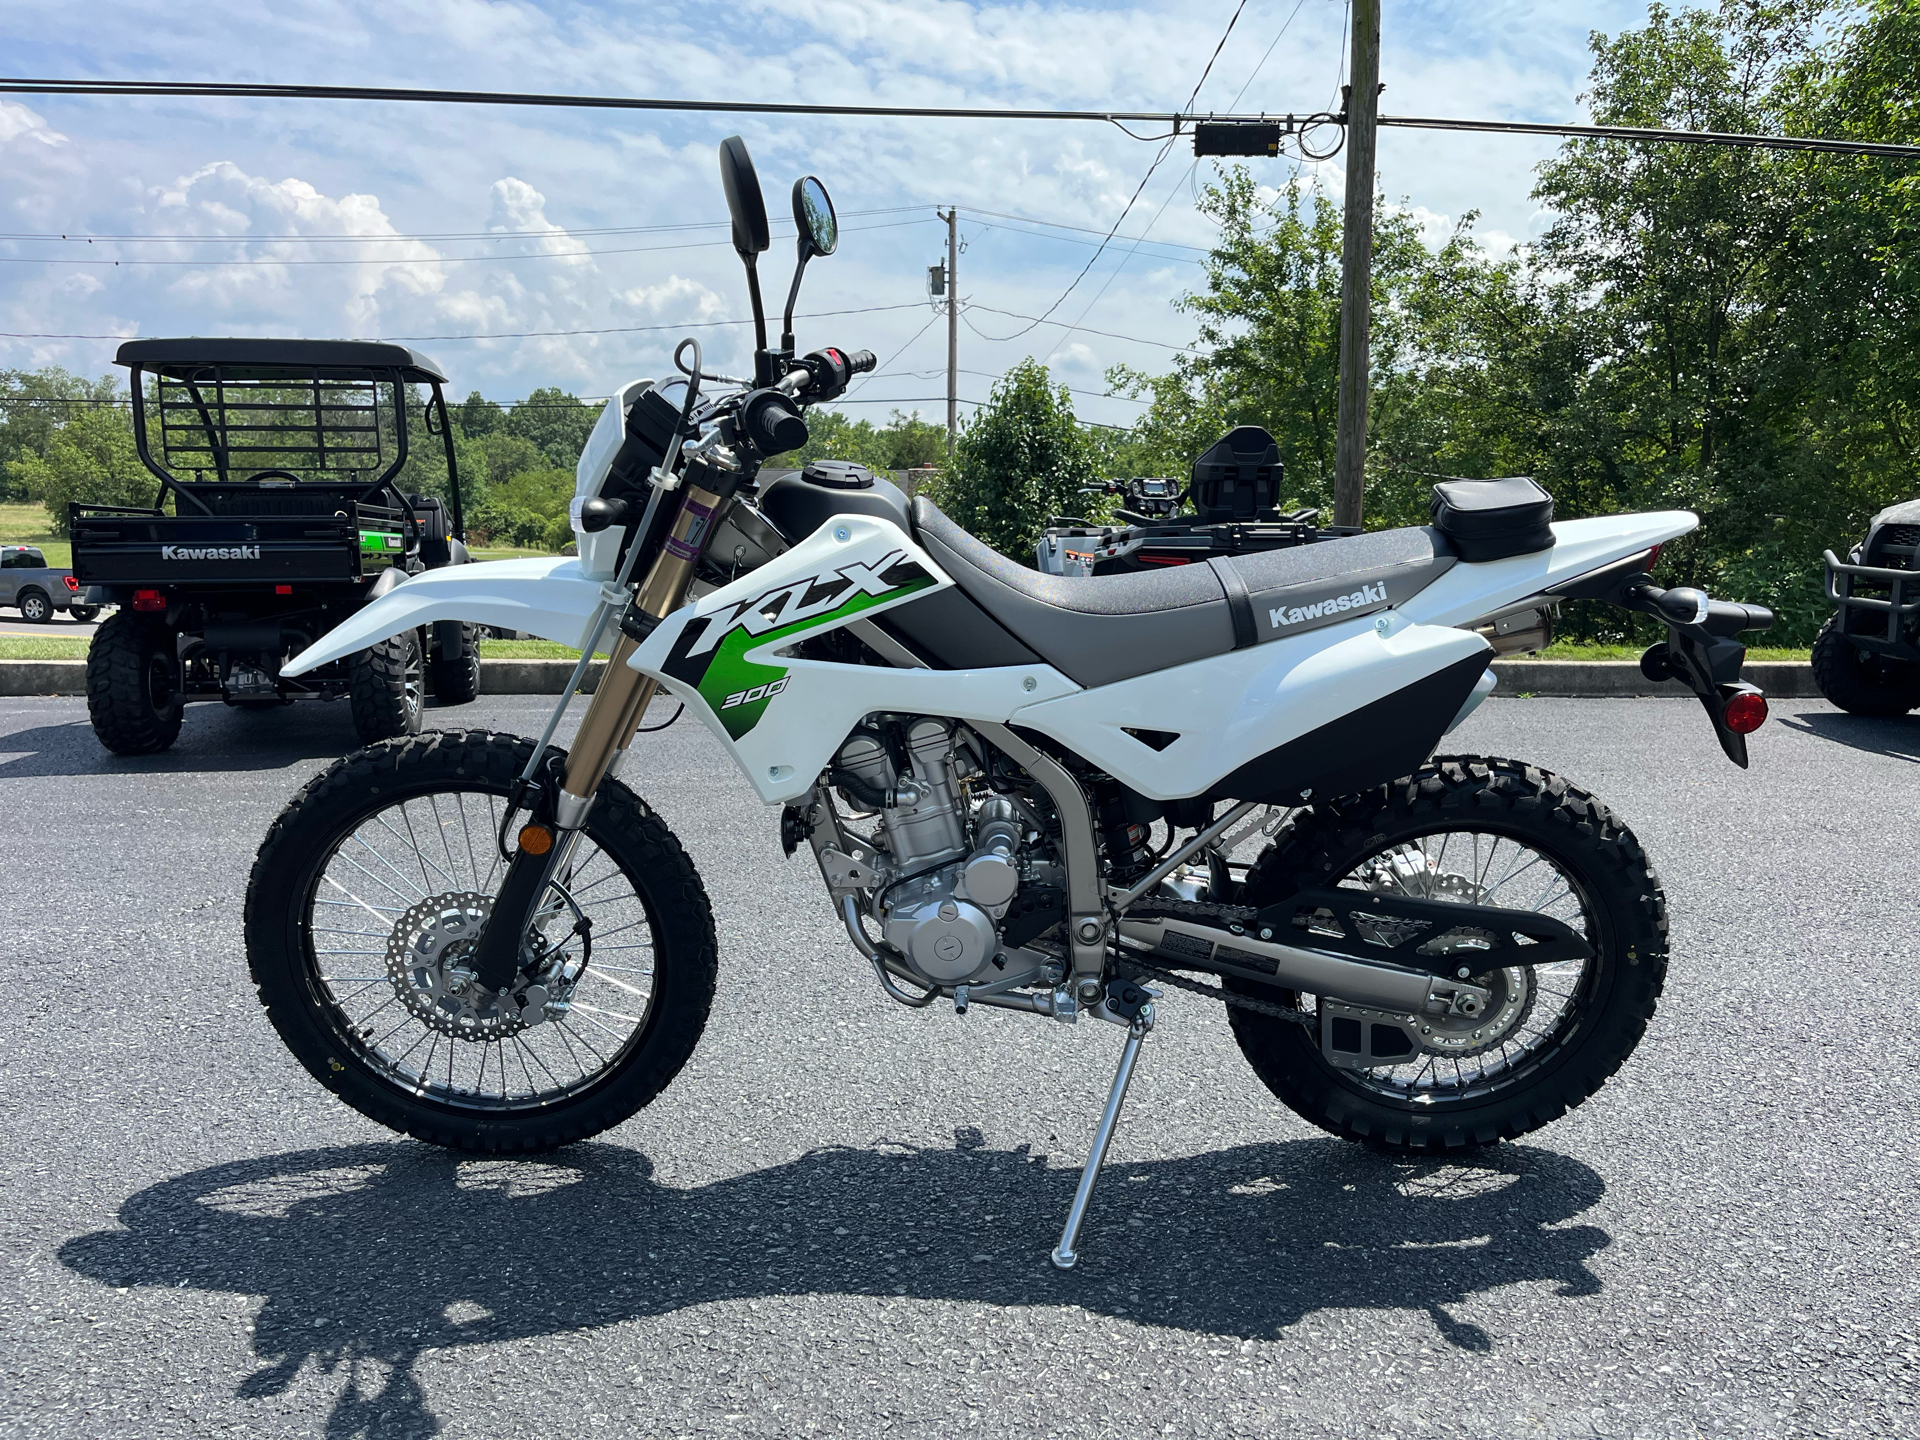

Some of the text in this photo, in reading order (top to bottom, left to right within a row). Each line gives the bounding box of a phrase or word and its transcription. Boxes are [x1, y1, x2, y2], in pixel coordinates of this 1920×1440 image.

[162, 545, 260, 560] Kawasaki
[685, 549, 908, 658] KLX
[1268, 580, 1387, 628] Kawasaki
[719, 675, 792, 711] 300
